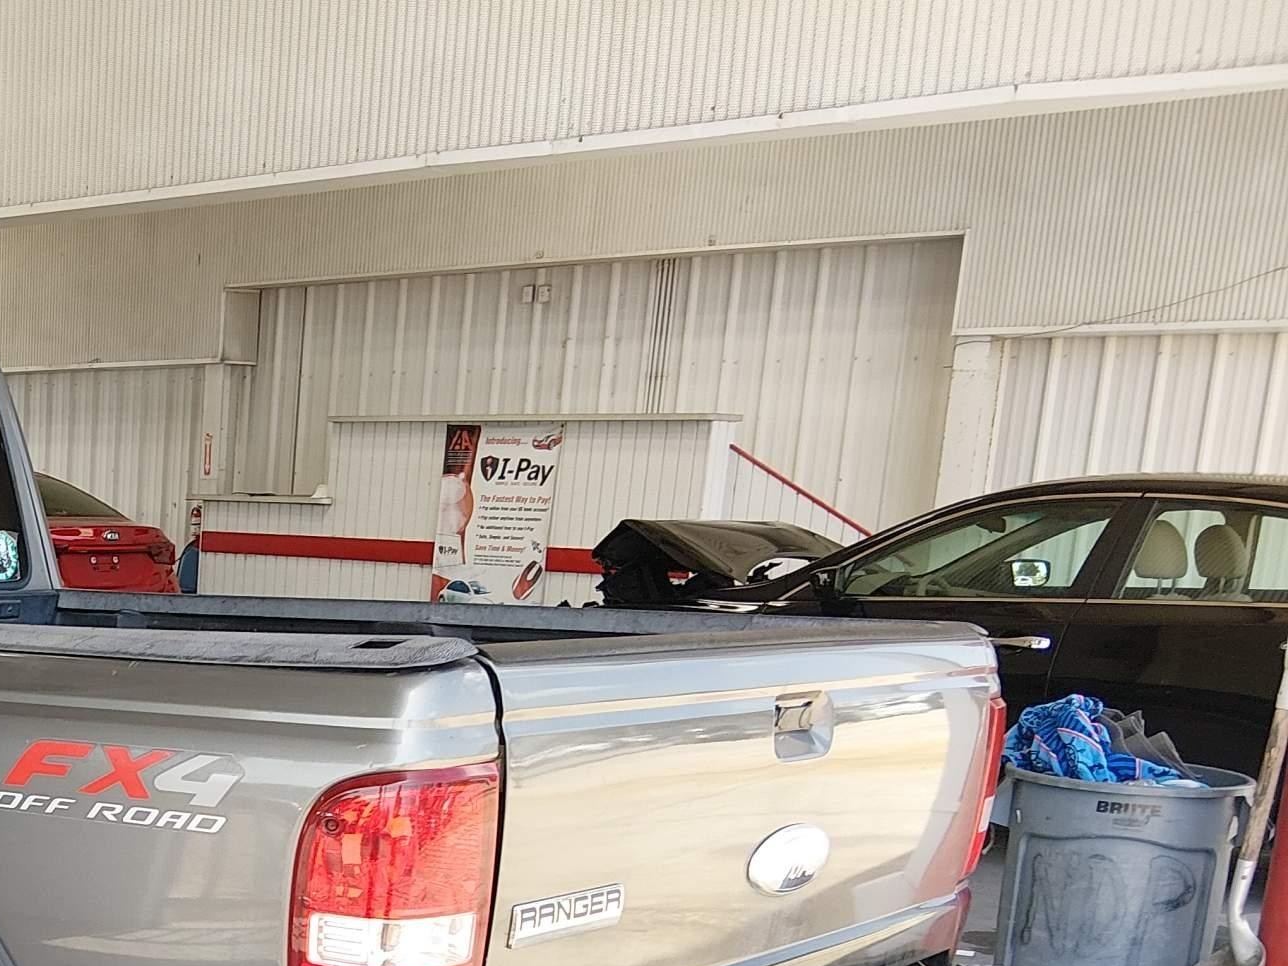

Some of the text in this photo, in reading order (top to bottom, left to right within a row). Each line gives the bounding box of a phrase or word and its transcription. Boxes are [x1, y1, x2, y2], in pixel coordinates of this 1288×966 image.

[498, 458, 555, 486] I-Pay
[2, 738, 242, 808] FX4
[86, 802, 228, 834] ROAD
[1096, 800, 1162, 816] BRUTE
[519, 888, 622, 931] RANGER
